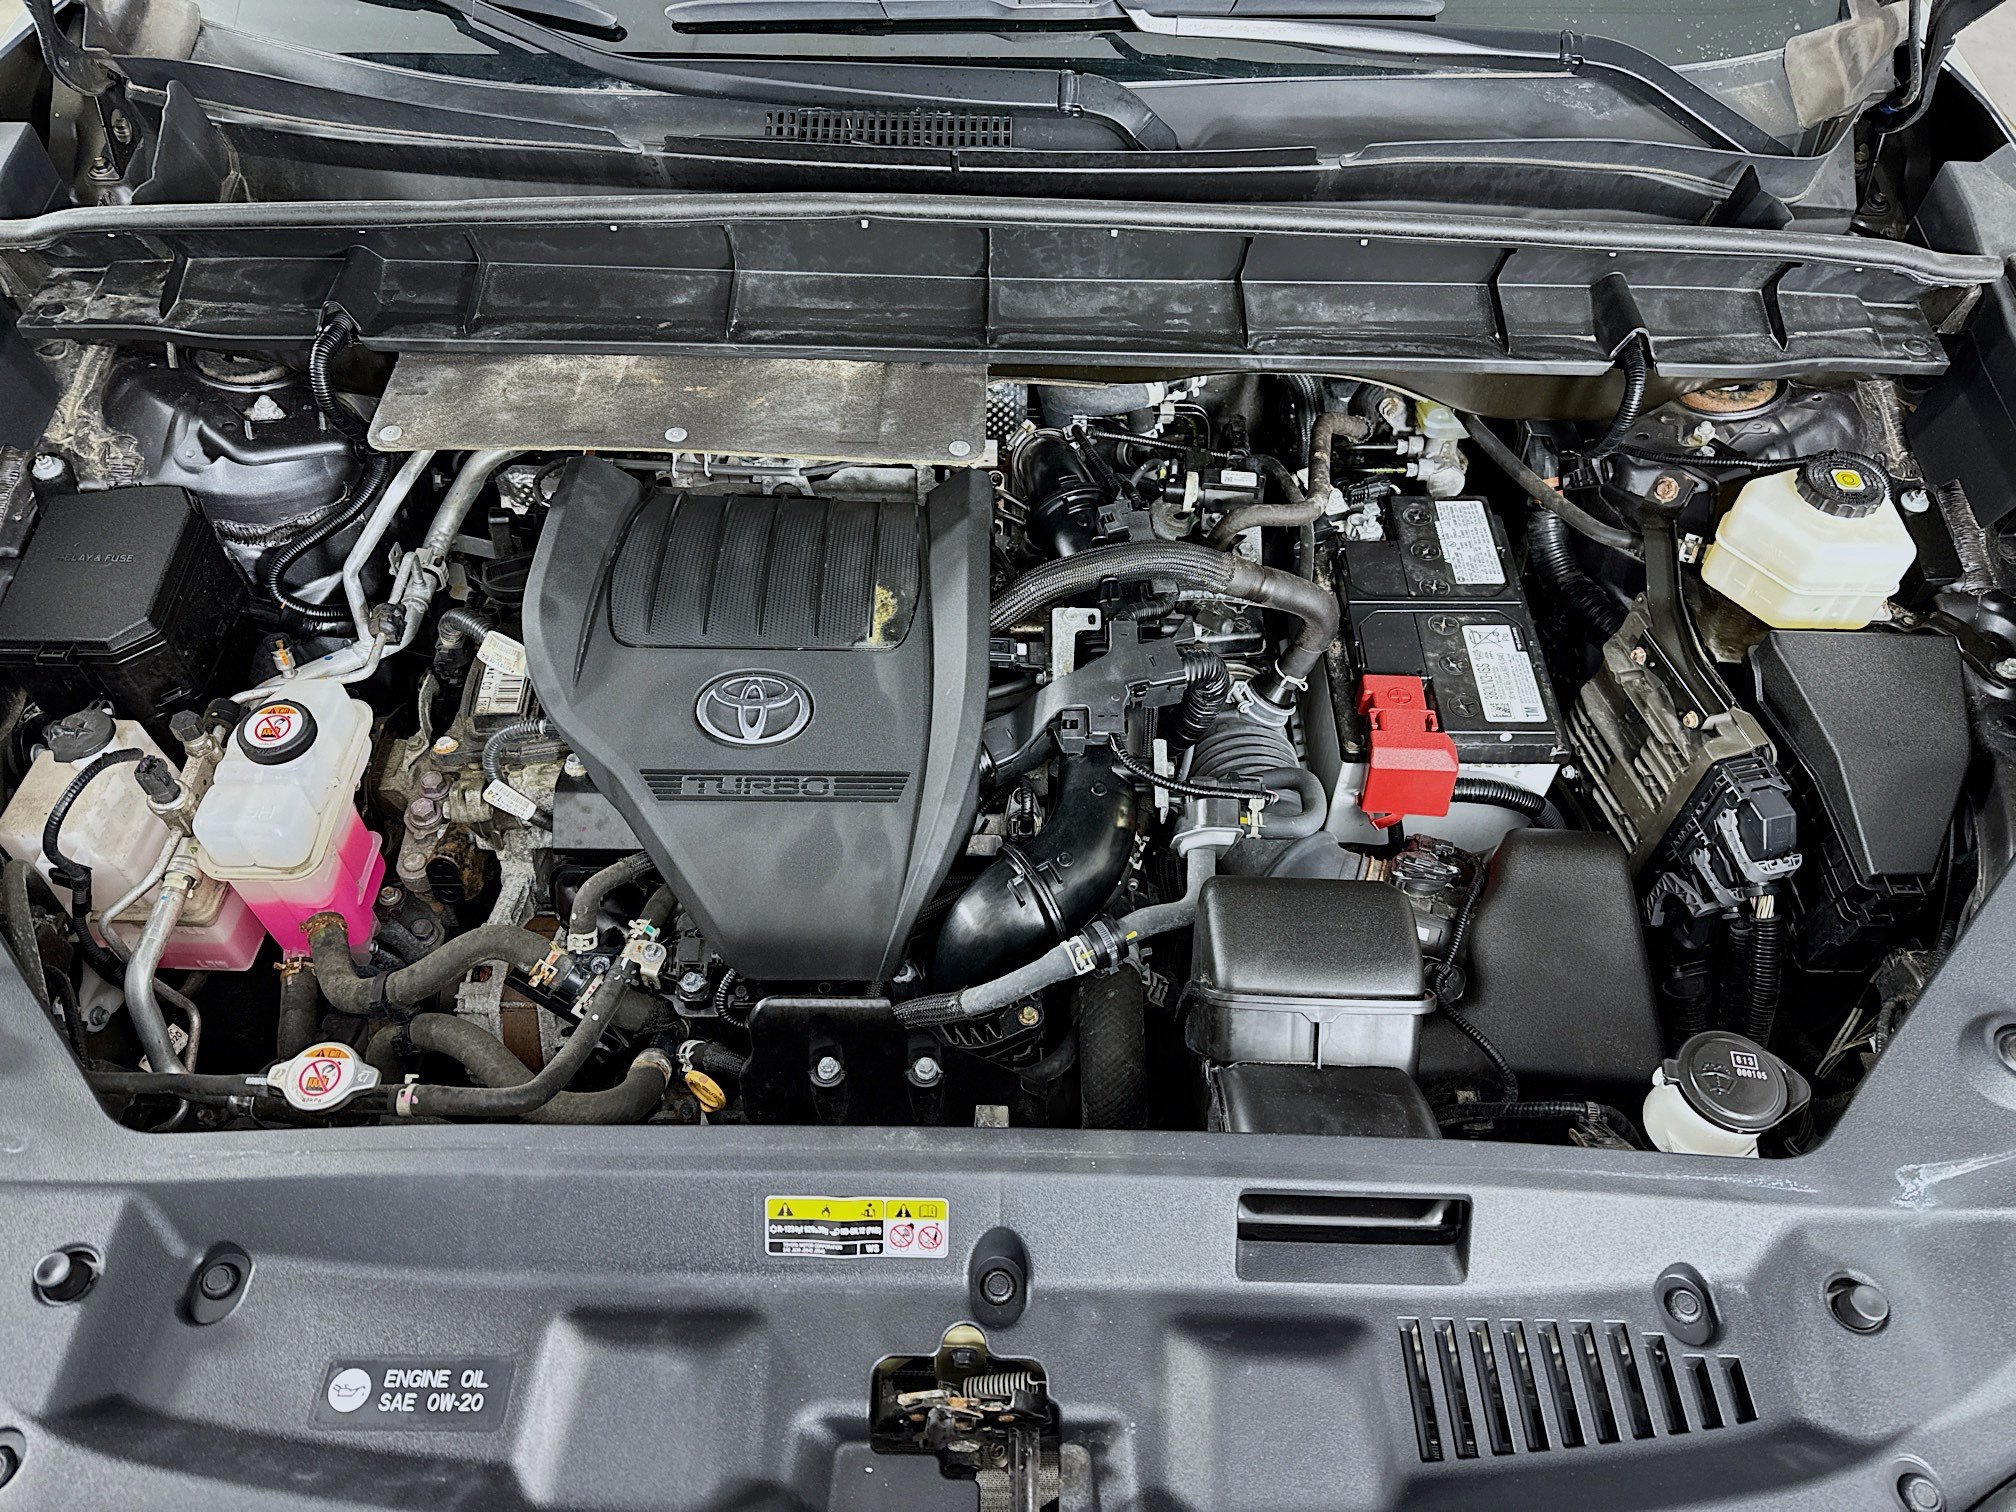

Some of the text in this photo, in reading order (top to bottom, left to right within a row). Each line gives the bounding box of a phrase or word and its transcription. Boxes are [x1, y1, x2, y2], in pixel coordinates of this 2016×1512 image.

[104, 553, 134, 562] FUSE
[686, 776, 831, 796] TURBO
[1736, 1068, 1768, 1080] 000105
[383, 1369, 489, 1389] ENGINE OIL
[378, 1392, 484, 1412] SAE 0W-20
